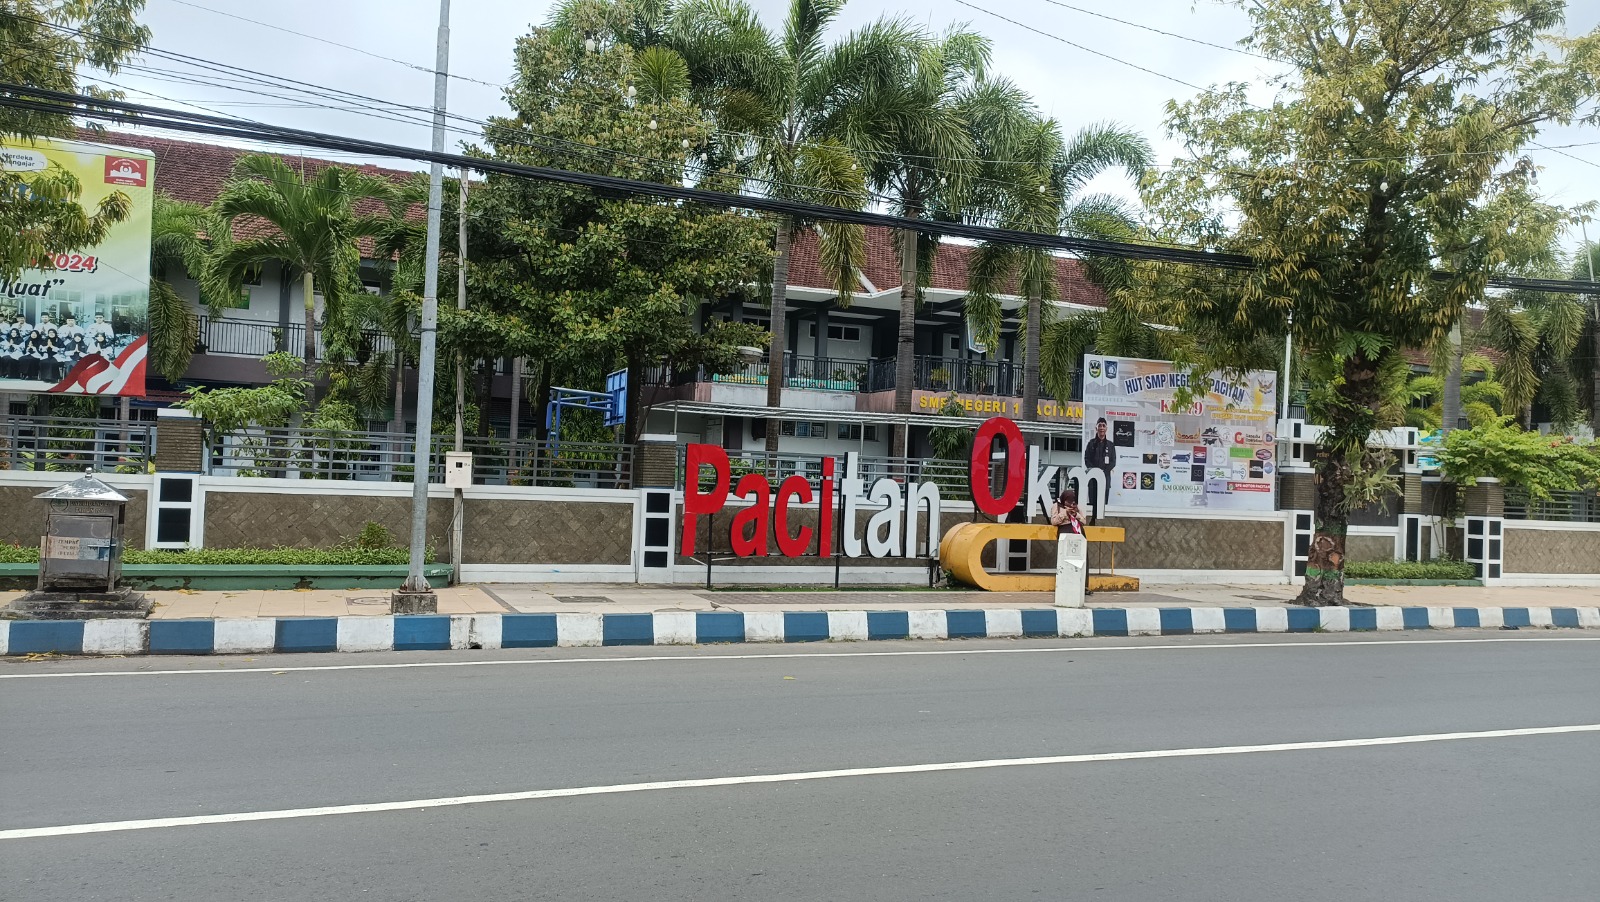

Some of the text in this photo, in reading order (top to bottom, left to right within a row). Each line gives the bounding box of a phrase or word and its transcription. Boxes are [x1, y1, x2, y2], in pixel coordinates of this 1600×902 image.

[1125, 377, 1143, 394] HUT
[1146, 374, 1166, 389] SMP
[1169, 373, 1191, 387] NEGE
[1013, 403, 1019, 414] 1
[681, 442, 941, 558] Pacitan
